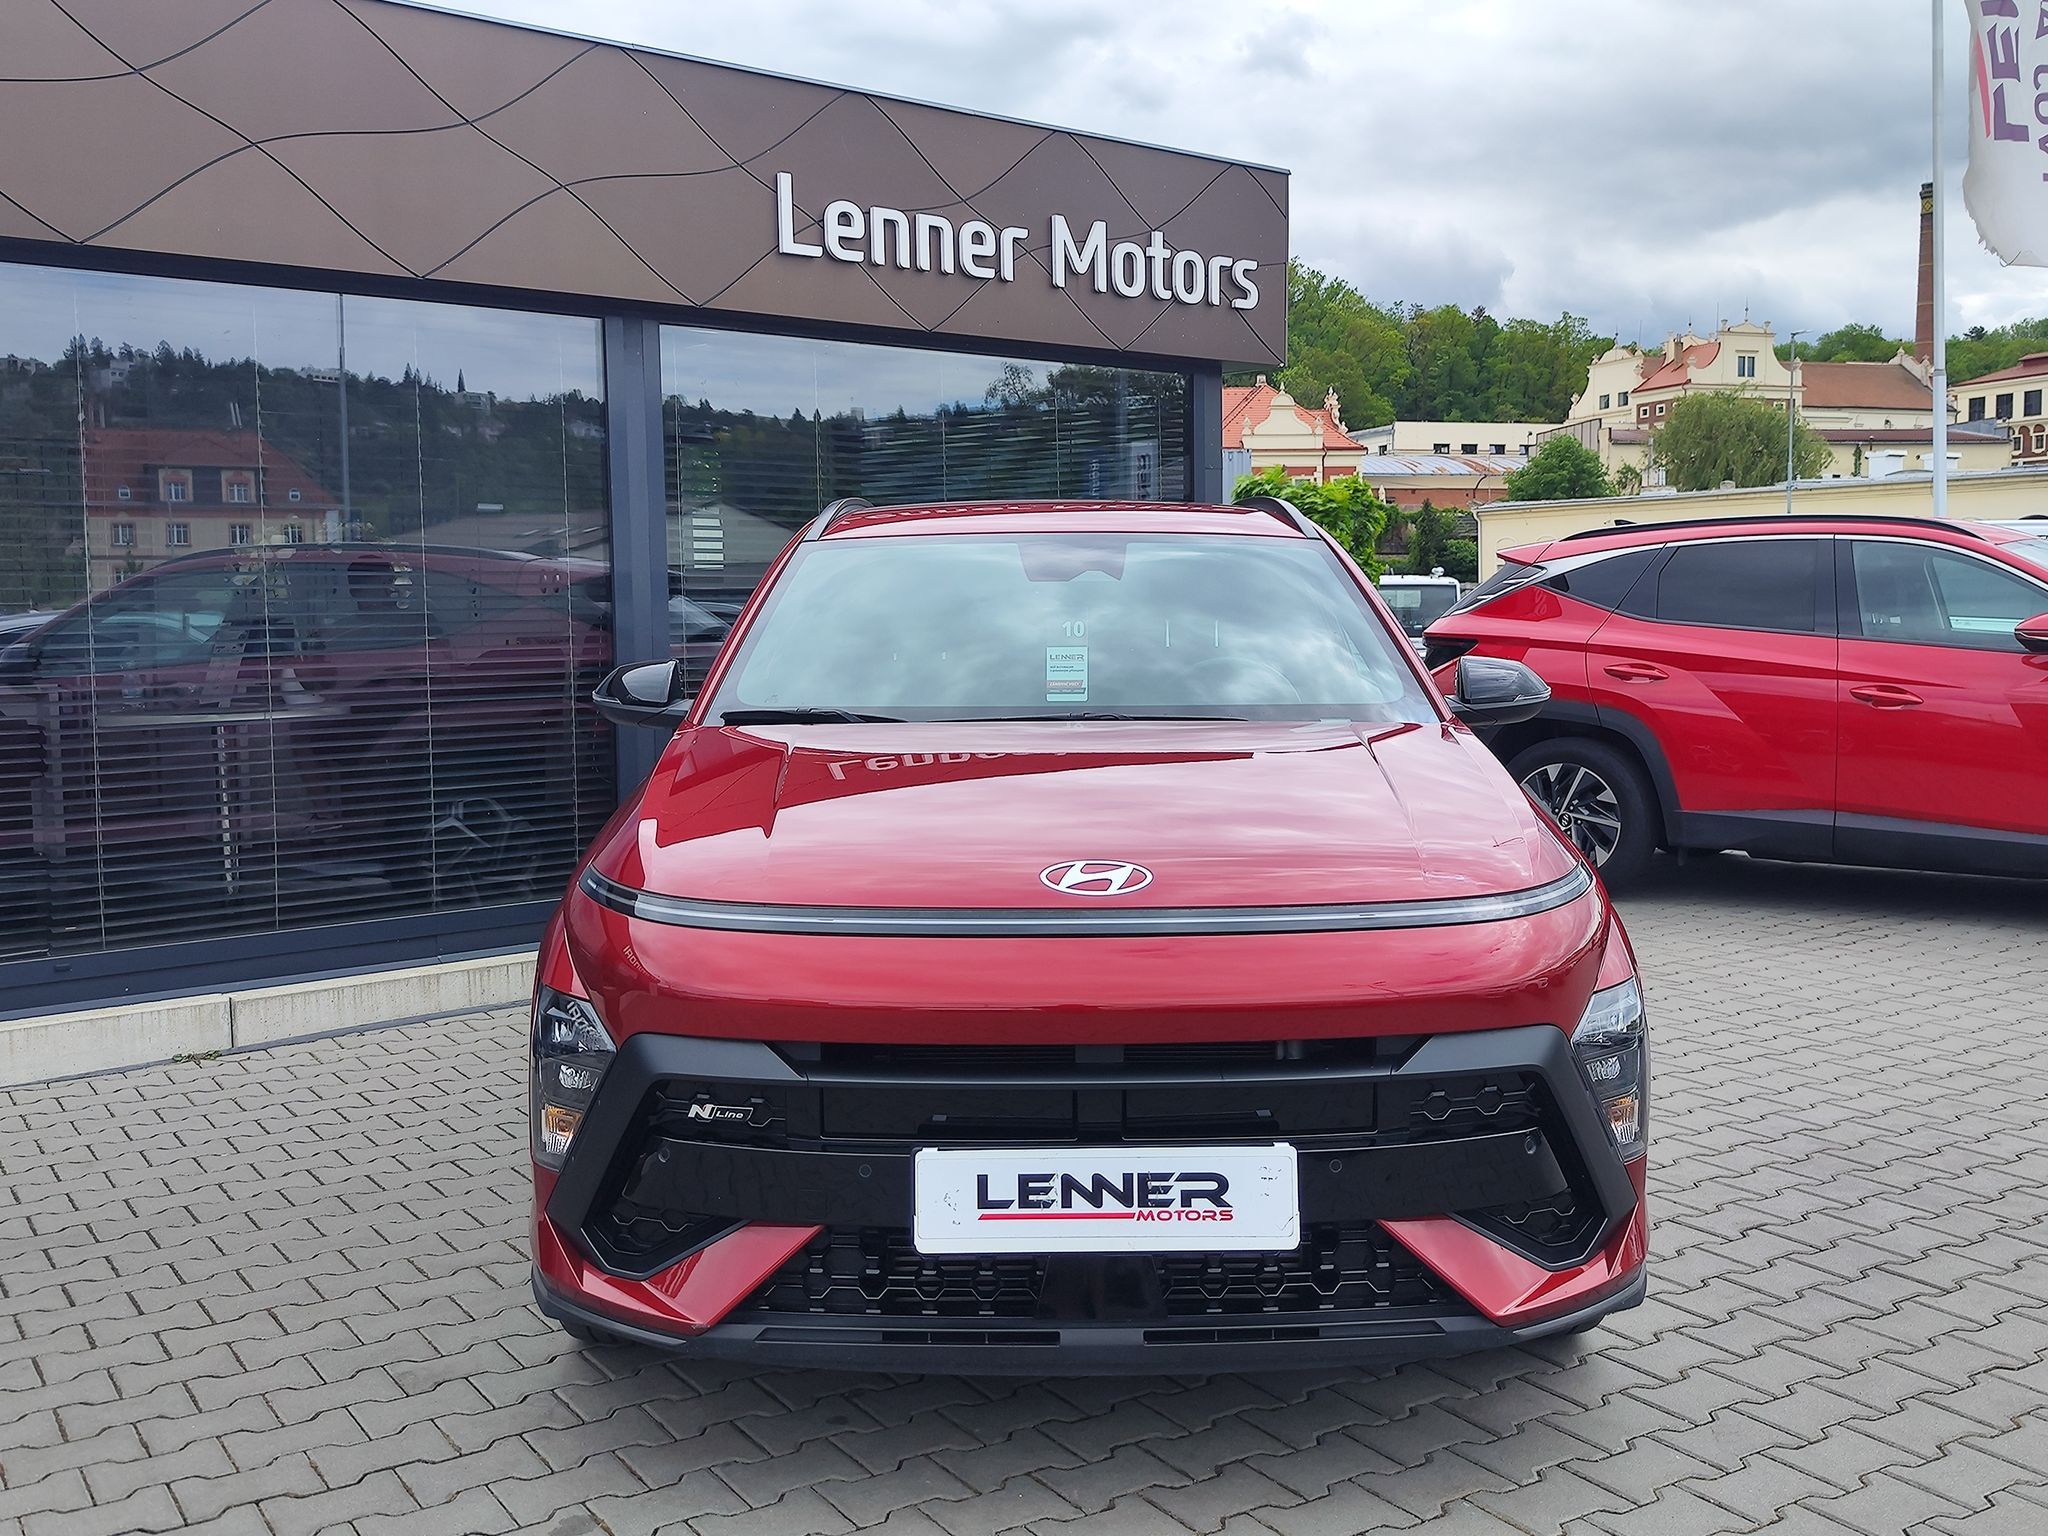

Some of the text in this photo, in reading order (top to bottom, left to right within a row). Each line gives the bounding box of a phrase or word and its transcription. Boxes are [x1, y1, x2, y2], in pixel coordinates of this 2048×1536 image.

[776, 171, 1260, 309] Lenner Motors
[1062, 620, 1085, 638] 10
[688, 1104, 744, 1119] N Line
[977, 1172, 1233, 1210] LENNER
[1136, 1209, 1234, 1222] MOTORS
